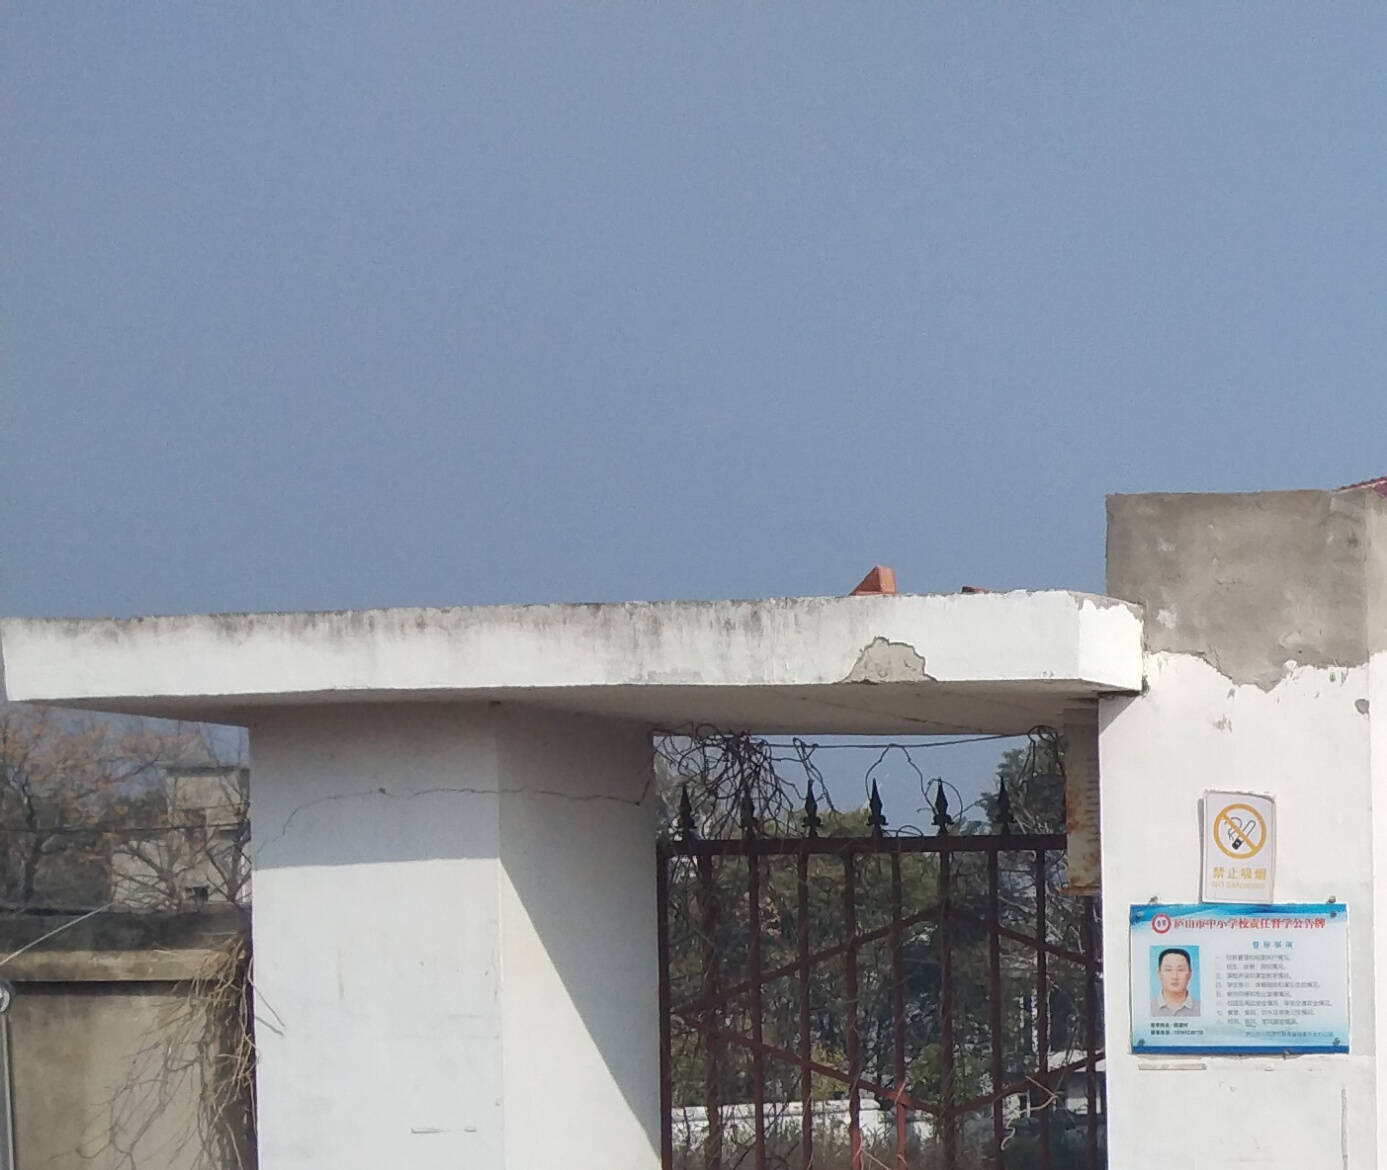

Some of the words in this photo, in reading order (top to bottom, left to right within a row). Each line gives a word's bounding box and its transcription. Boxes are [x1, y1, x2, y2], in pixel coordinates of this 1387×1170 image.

[1213, 866, 1267, 880] 禁止吸烟
[1173, 917, 1326, 930] 庐山市中小学校责任督学公告牌
